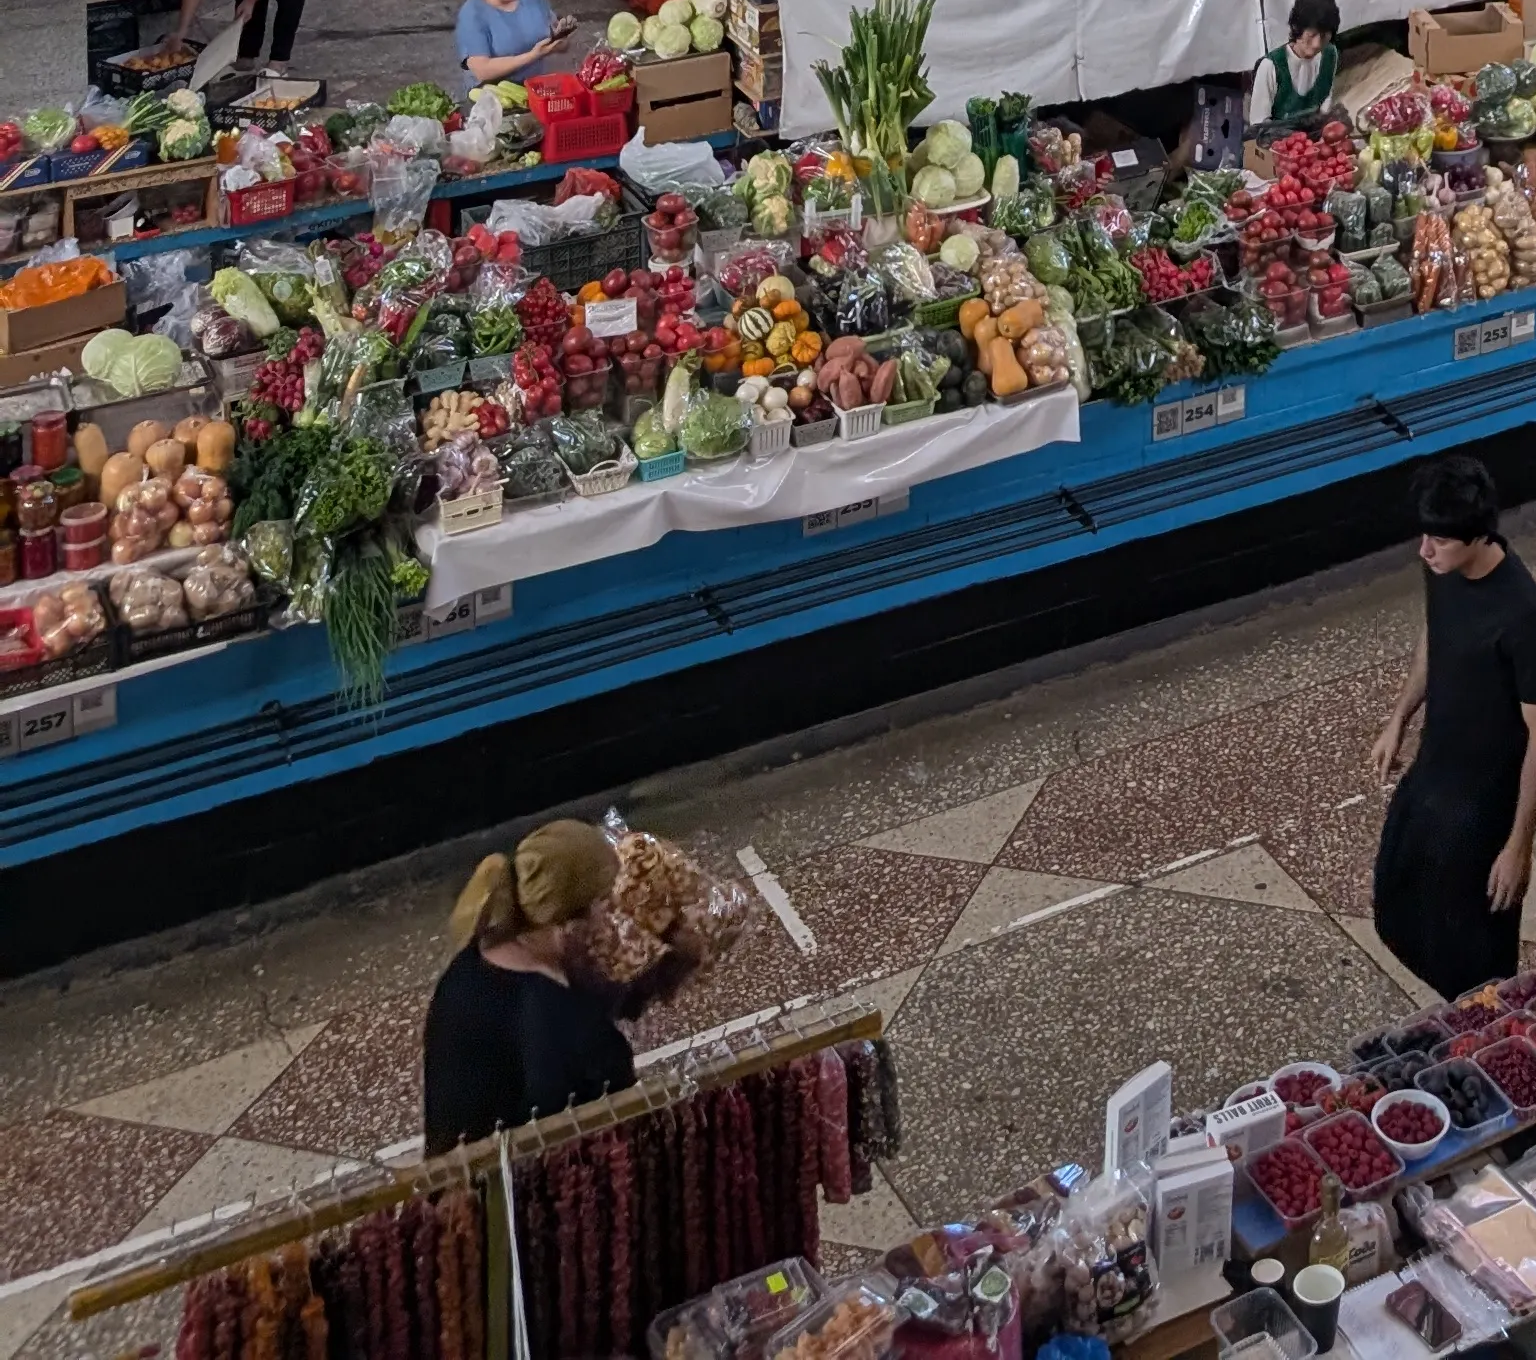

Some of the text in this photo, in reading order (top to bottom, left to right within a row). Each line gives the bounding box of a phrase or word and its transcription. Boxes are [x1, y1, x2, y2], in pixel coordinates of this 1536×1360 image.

[1483, 327, 1508, 343] 253
[1185, 404, 1213, 422] 254
[24, 711, 67, 737] 257
[1247, 1093, 1278, 1113] FRUIT
[1212, 1105, 1247, 1125] BALLS
